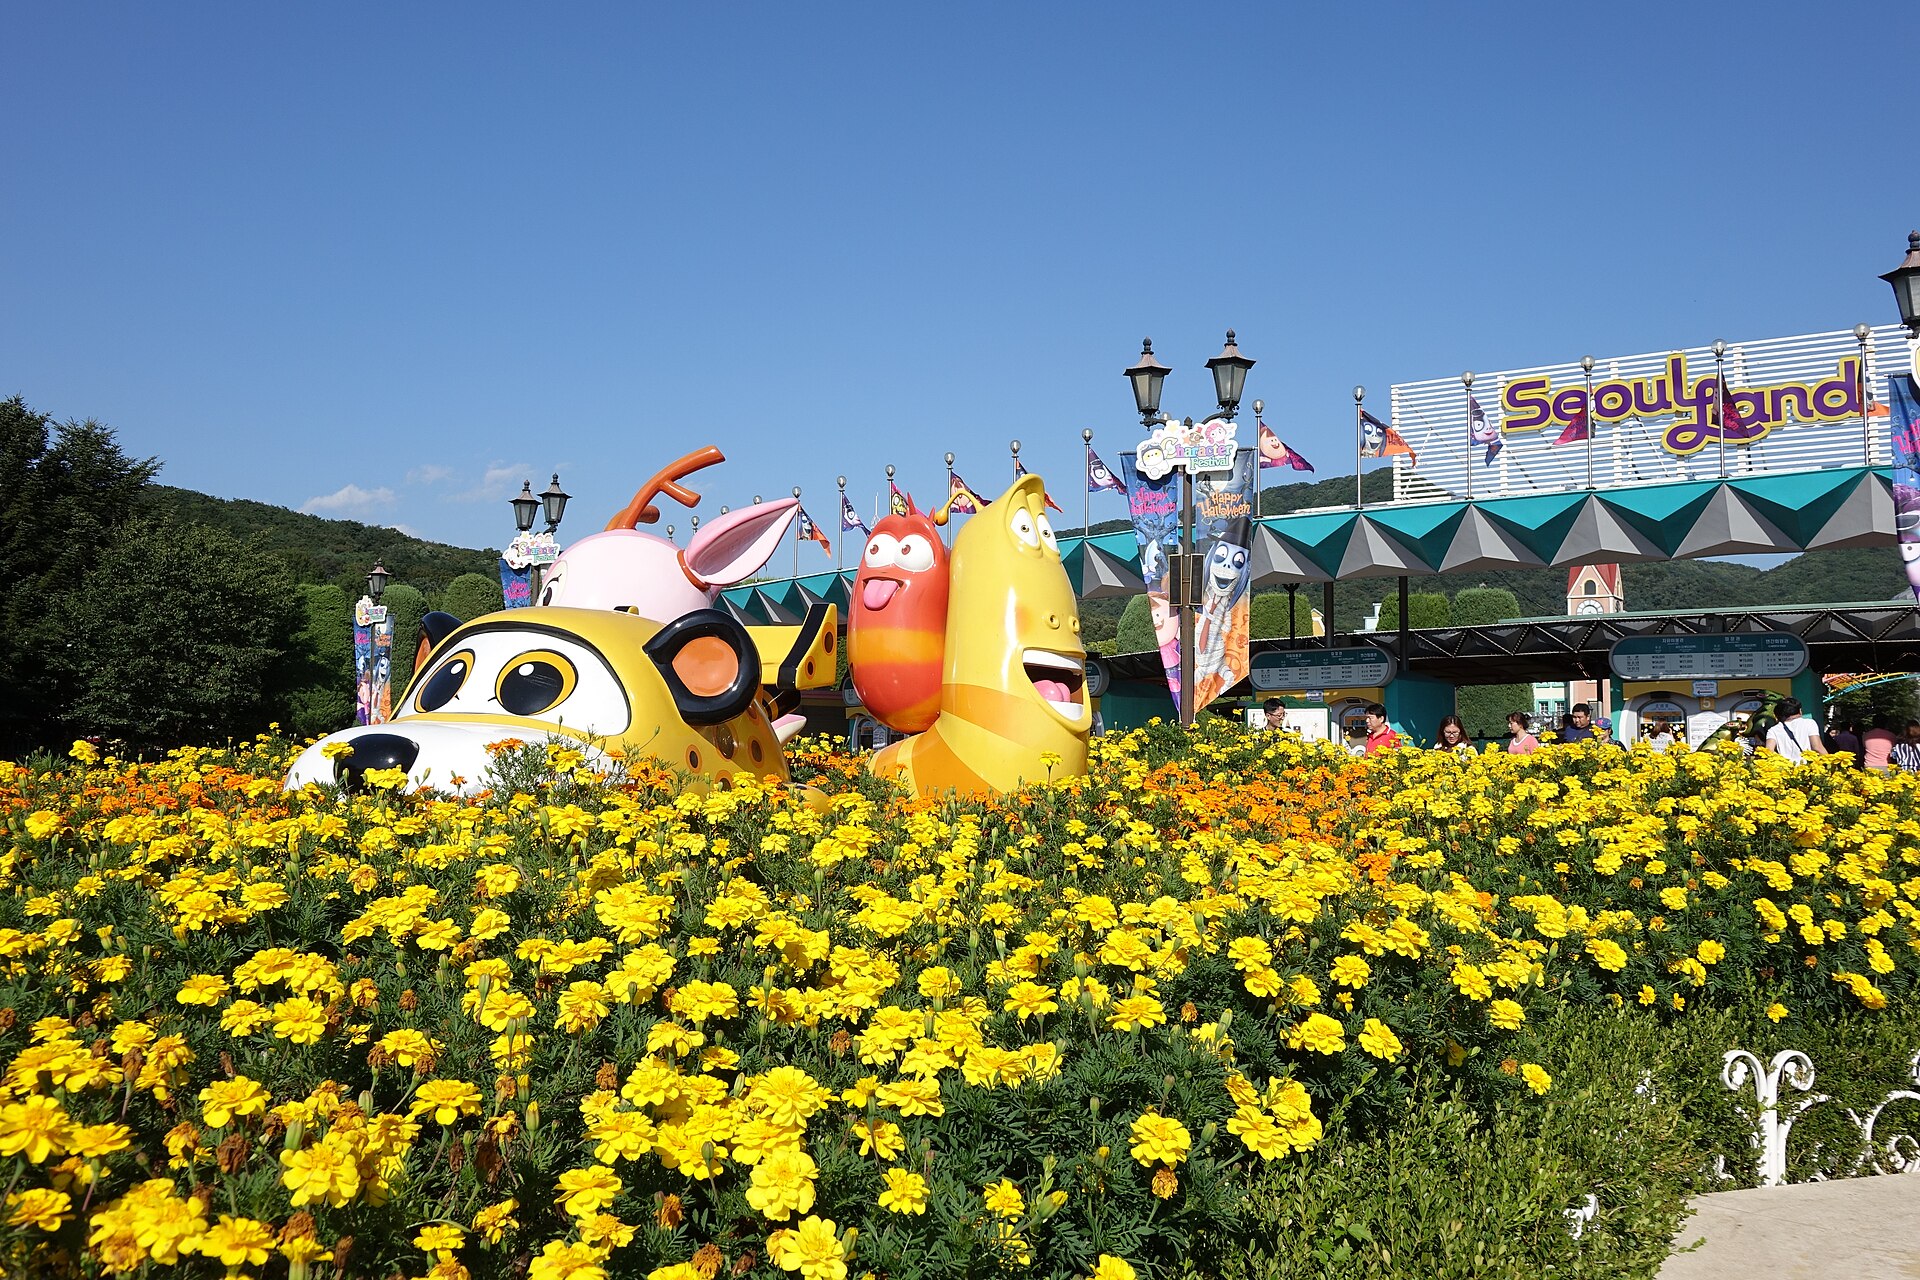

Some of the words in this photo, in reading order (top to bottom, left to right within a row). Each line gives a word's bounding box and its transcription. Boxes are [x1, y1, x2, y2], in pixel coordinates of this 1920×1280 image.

[1160, 437, 1233, 460] Character
[1190, 456, 1230, 470] Festival
[1136, 487, 1168, 502] Happy
[1211, 489, 1243, 504] Happy
[1197, 497, 1251, 517] Halloween
[1702, 698, 1711, 708] 5
